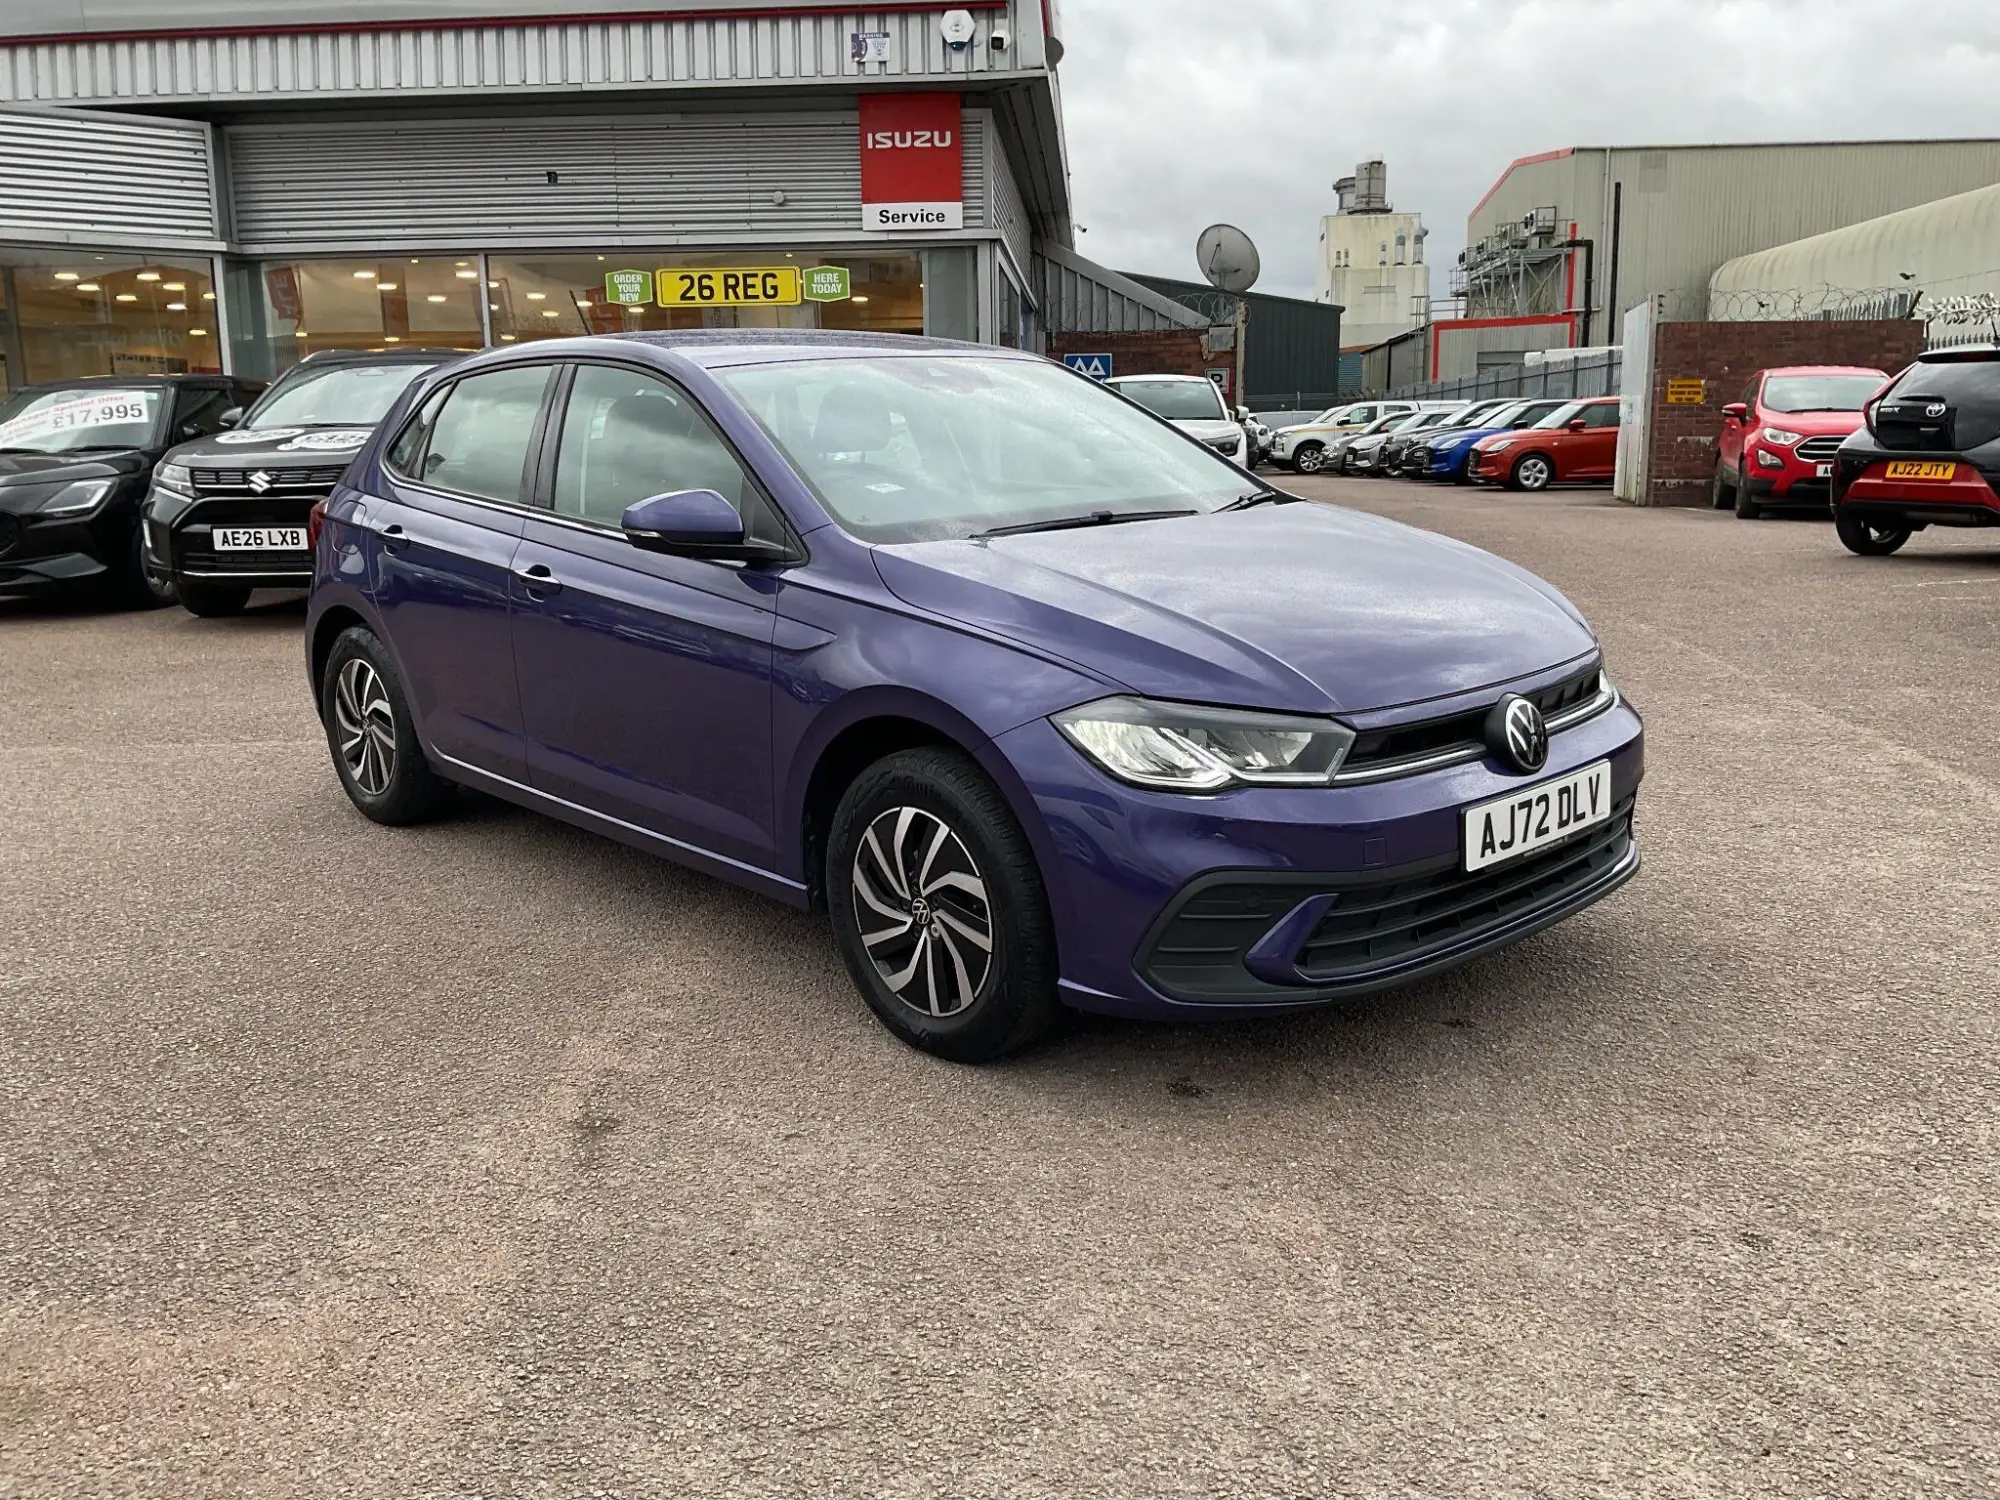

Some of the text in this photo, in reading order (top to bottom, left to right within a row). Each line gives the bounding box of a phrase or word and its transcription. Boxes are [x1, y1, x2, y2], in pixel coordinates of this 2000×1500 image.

[867, 131, 951, 149] ISUZU
[879, 209, 945, 223] Service
[613, 274, 643, 284] ORDER
[814, 272, 839, 284] HERE
[617, 284, 641, 293] YOUR
[679, 272, 779, 301] 26 REG
[812, 283, 842, 294] TODAY
[619, 293, 639, 302] NEW
[97, 396, 125, 404] Offer
[53, 403, 143, 429] £17,995
[1891, 463, 1950, 477] AJ22 JTY
[222, 530, 300, 547] AE26 LXB
[1480, 772, 1600, 859] AJ72 DLV
